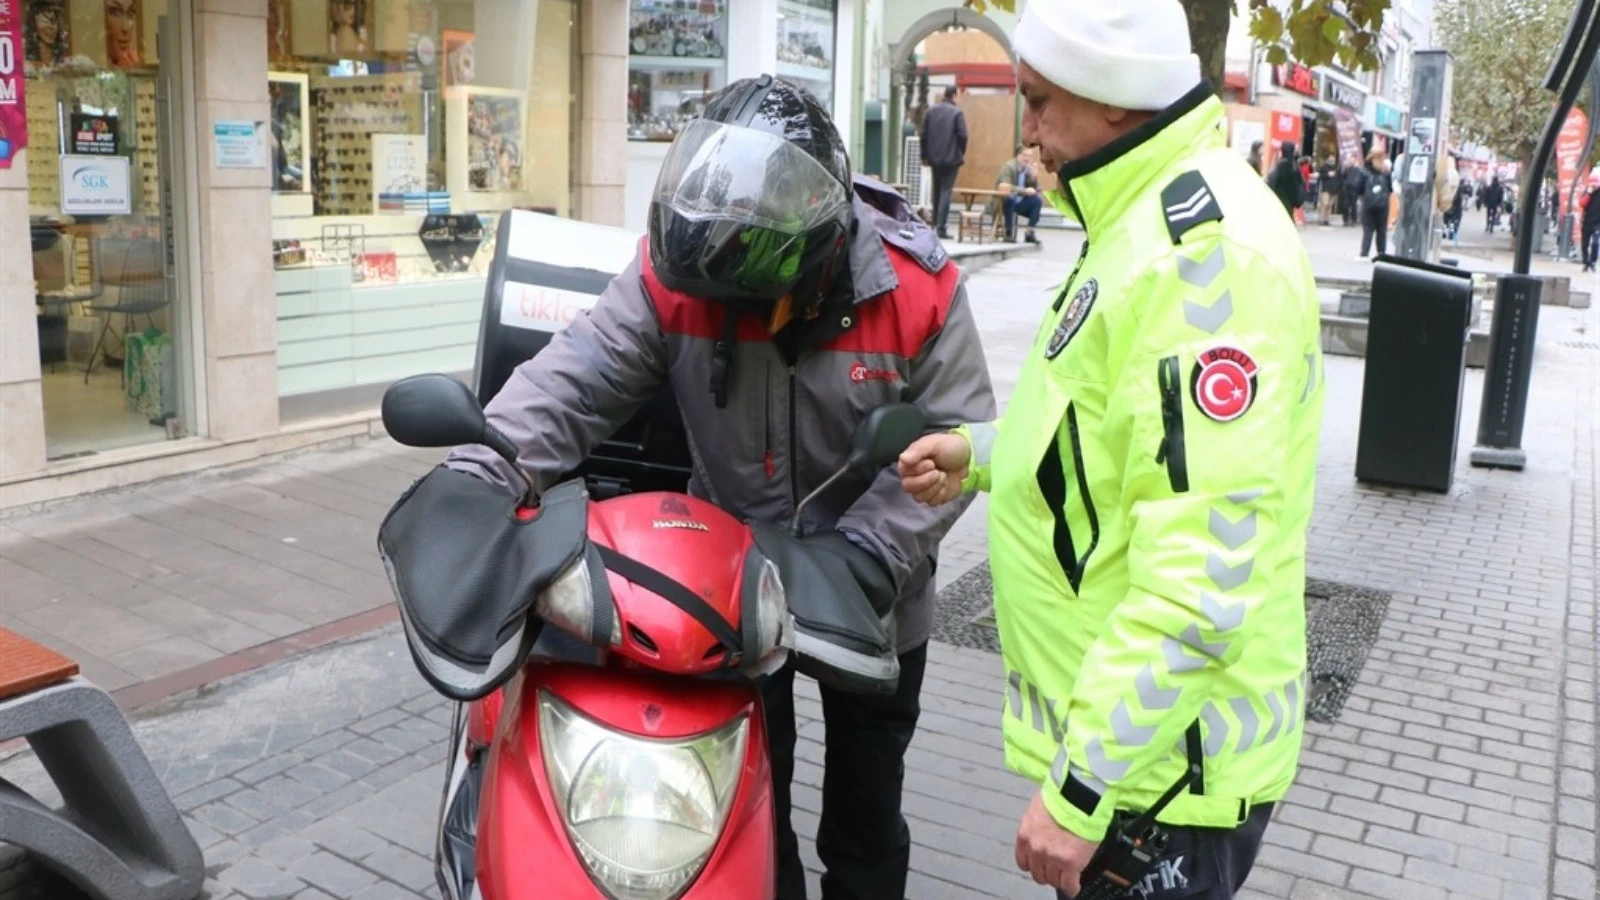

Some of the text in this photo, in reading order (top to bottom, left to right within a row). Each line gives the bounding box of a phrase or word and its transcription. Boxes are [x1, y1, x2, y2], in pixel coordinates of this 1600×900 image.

[81, 175, 109, 188] SGK
[1207, 348, 1250, 368] BOLU
[653, 519, 709, 532] HONDA
